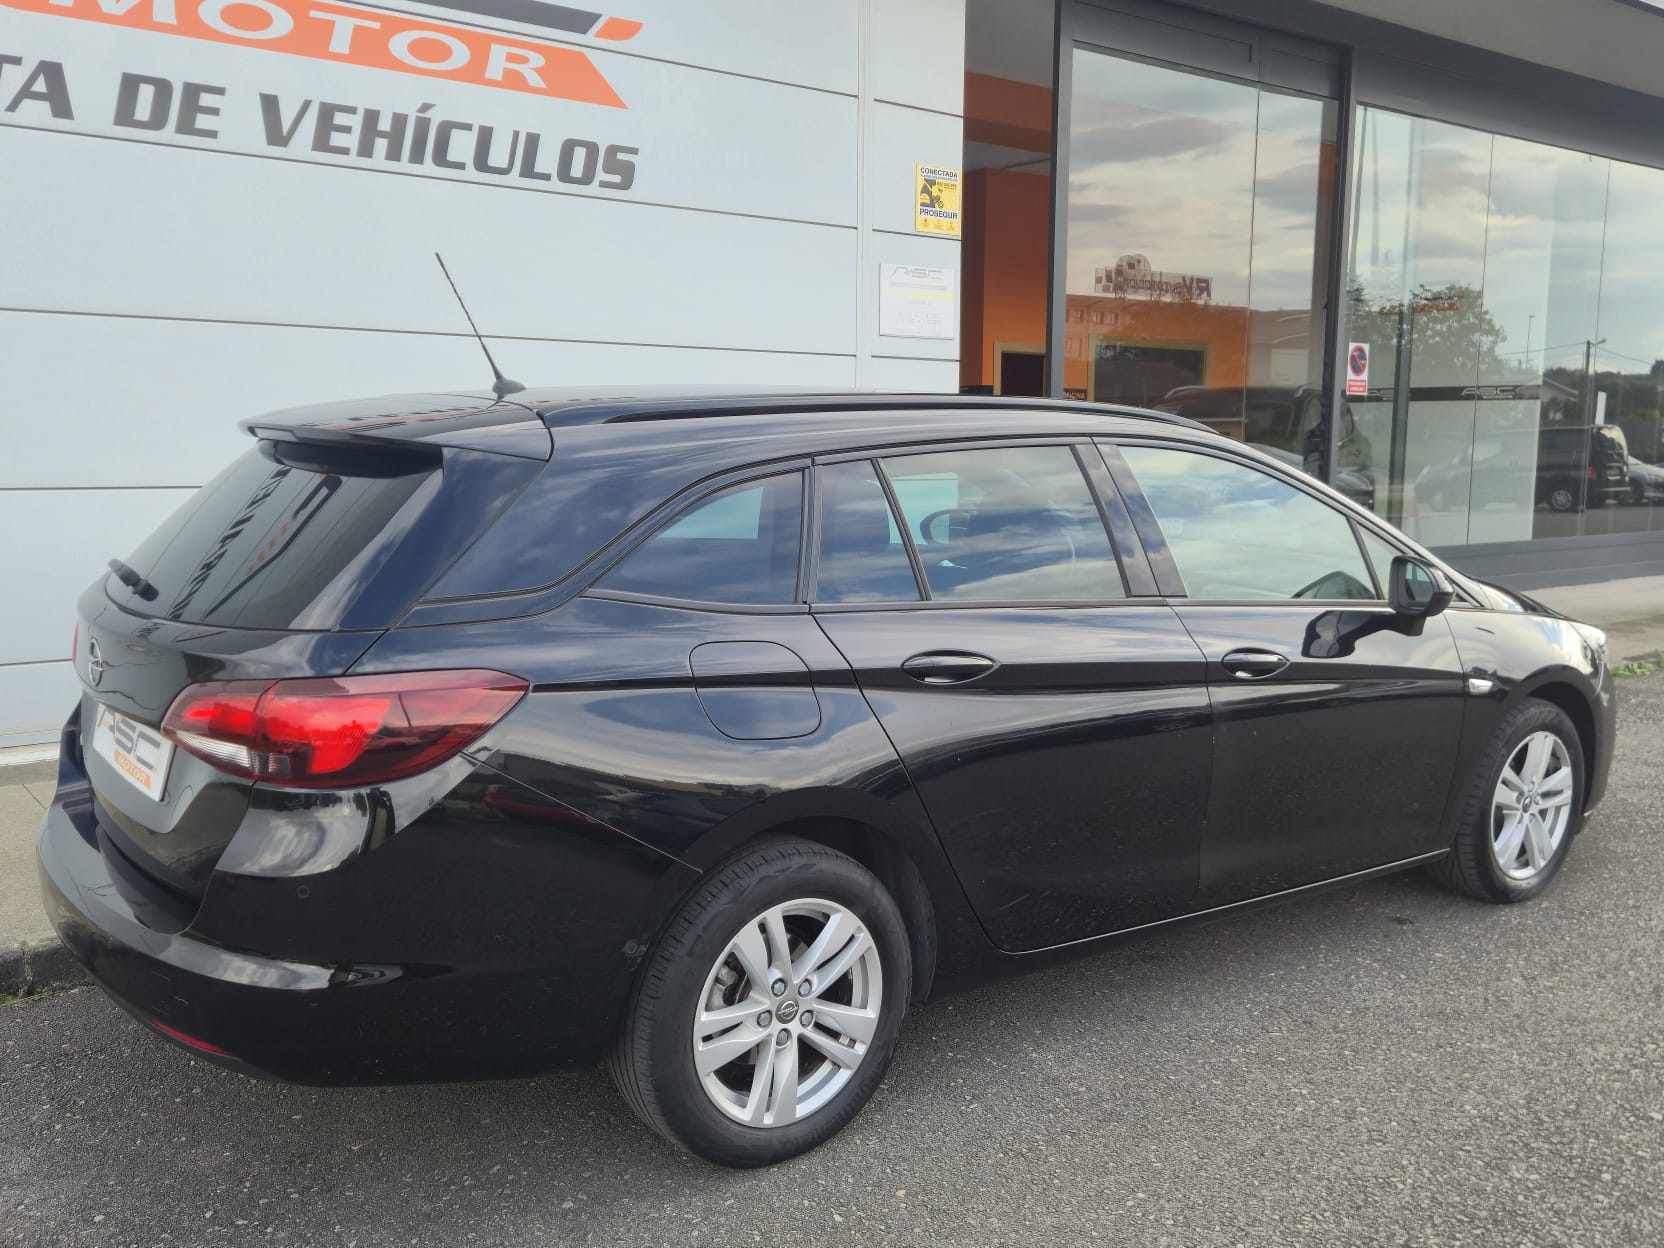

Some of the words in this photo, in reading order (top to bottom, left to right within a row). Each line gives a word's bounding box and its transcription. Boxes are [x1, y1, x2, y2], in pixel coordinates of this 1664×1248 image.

[112, 71, 227, 139] DE
[258, 92, 640, 191] VEHÍCULOS
[920, 167, 958, 178] CONECTADA
[919, 208, 958, 219] PROSEGUR
[119, 754, 147, 783] MOTOR
